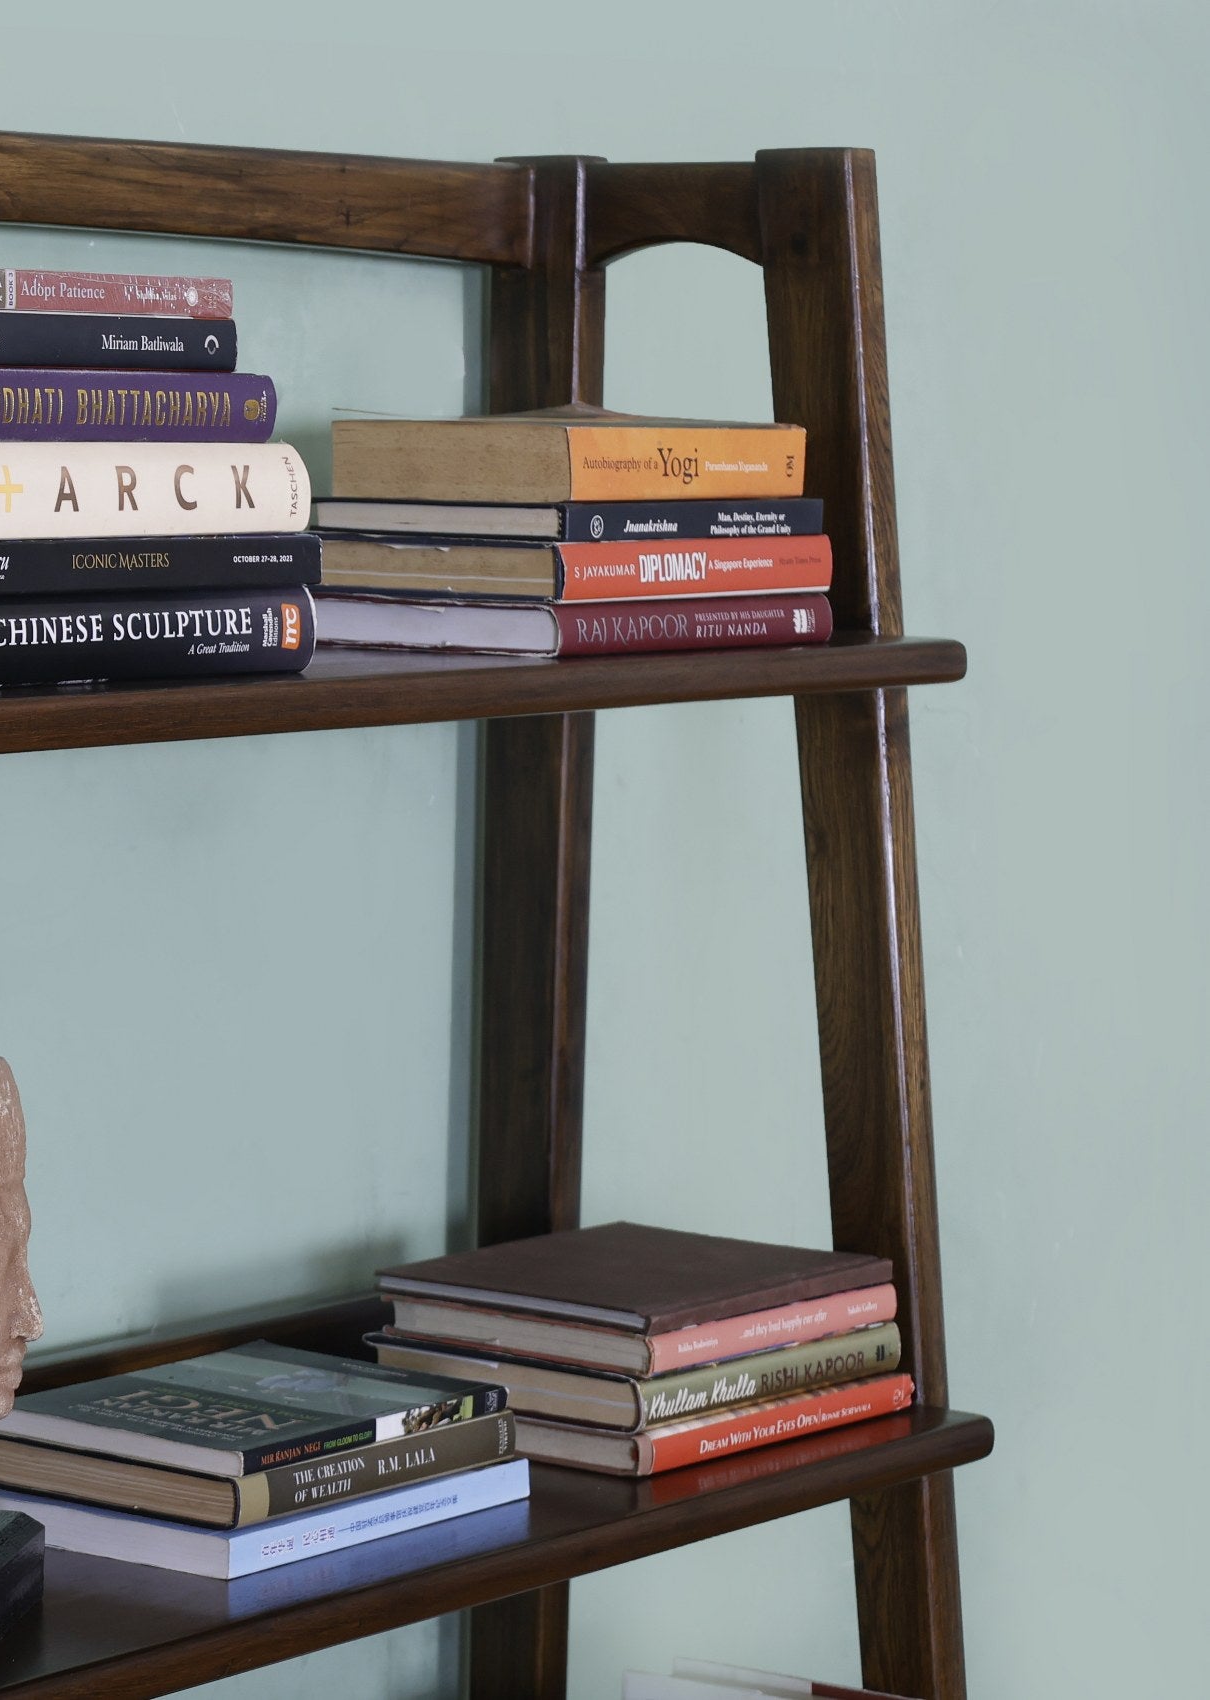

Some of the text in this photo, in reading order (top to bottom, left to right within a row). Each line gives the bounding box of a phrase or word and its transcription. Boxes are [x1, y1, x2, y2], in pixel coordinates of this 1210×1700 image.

[21, 279, 105, 300] Adopt Patience
[101, 334, 184, 353] Miriam Batliwala
[76, 389, 231, 427] BHATTACHARYA
[583, 448, 699, 484] Autobiography of a Yogi
[282, 456, 298, 517] TASCHEN
[624, 519, 678, 534] Jnanakrishna
[717, 512, 732, 523] Man,
[756, 512, 778, 523] Eternity
[778, 513, 786, 522] or
[710, 524, 791, 537] Philosophy of the Grand Unity
[72, 552, 170, 571] ICONIC MASTERS
[233, 555, 260, 563] OCTOBER
[261, 555, 278, 563] 27-28,
[639, 552, 707, 583] DIPLOMACY
[708, 558, 774, 572] A Singapore Experience
[574, 563, 636, 581] S JAYAKUMAR
[113, 607, 252, 641] SCULPTURE
[694, 609, 786, 622] PRESENTED BY HIS DAUGHTER
[576, 614, 689, 645] RAJ KAPOOR
[696, 622, 768, 638] RITU NANDA
[188, 640, 250, 655] A Great Tradition
[782, 1316, 802, 1335] happily
[761, 1351, 865, 1393] RISHI KAPOOR
[648, 1373, 757, 1420] Khullam Khulla
[324, 1437, 336, 1450] FROM
[336, 1435, 351, 1447] GLOOM
[350, 1434, 358, 1443] TO
[700, 1413, 819, 1454] DREAM WITH YOUR EYES OPEN
[261, 1441, 322, 1465] MIR RANJAN NEGI
[378, 1447, 436, 1475] R.M. LALA
[293, 1456, 366, 1485] THE CREATION
[294, 1478, 351, 1503] OF WEALTH
